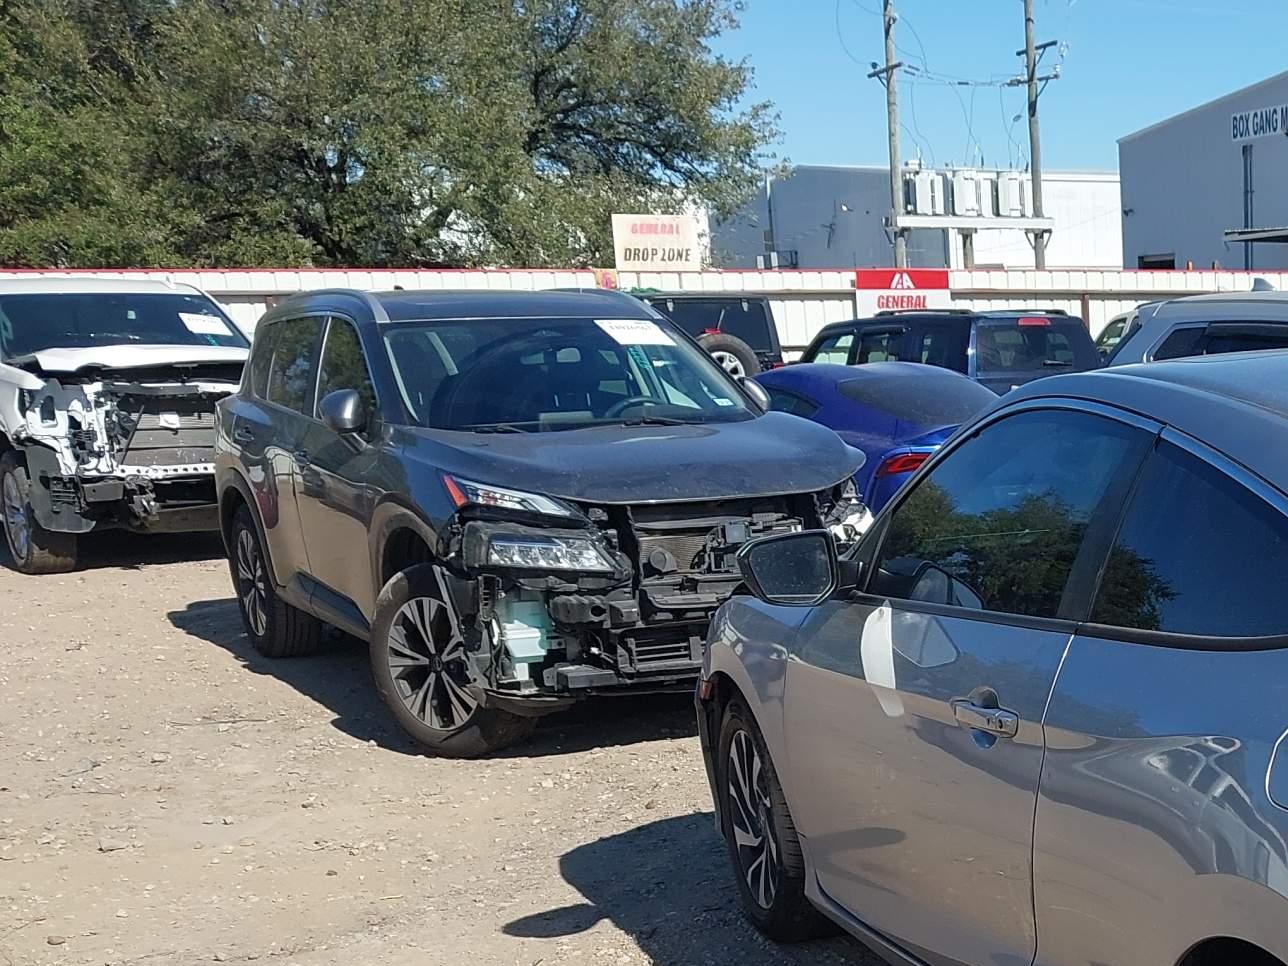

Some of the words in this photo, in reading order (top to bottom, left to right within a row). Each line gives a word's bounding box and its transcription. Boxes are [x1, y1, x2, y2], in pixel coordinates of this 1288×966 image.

[1232, 112, 1250, 139] BOX
[1252, 108, 1278, 136] GANG
[624, 247, 658, 262] DROP
[660, 247, 691, 262] ZONE
[877, 294, 927, 309] GENERAL
